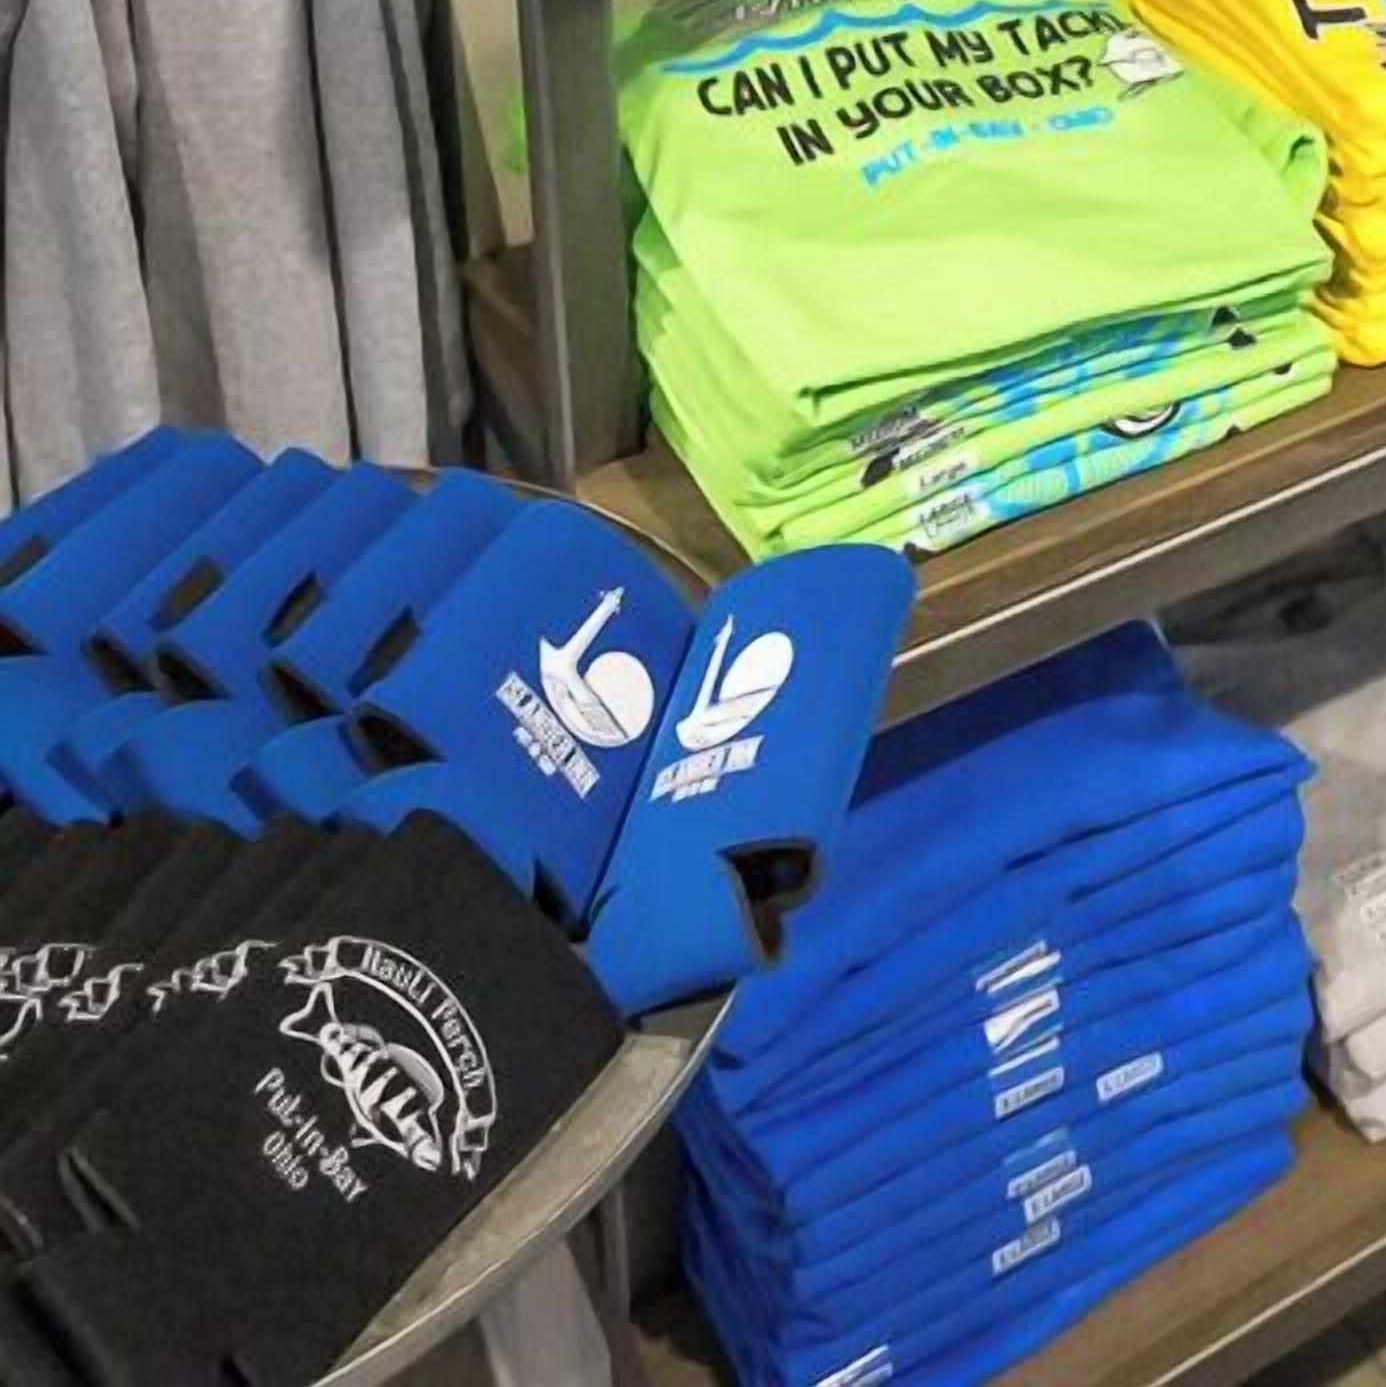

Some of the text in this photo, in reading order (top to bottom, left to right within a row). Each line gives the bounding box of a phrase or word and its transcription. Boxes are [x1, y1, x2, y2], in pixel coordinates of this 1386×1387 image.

[697, 63, 795, 116] CAN
[798, 55, 823, 99] I
[824, 31, 917, 91] PUT
[923, 28, 996, 69] MY
[776, 55, 1095, 167] IN YOUR BOX?
